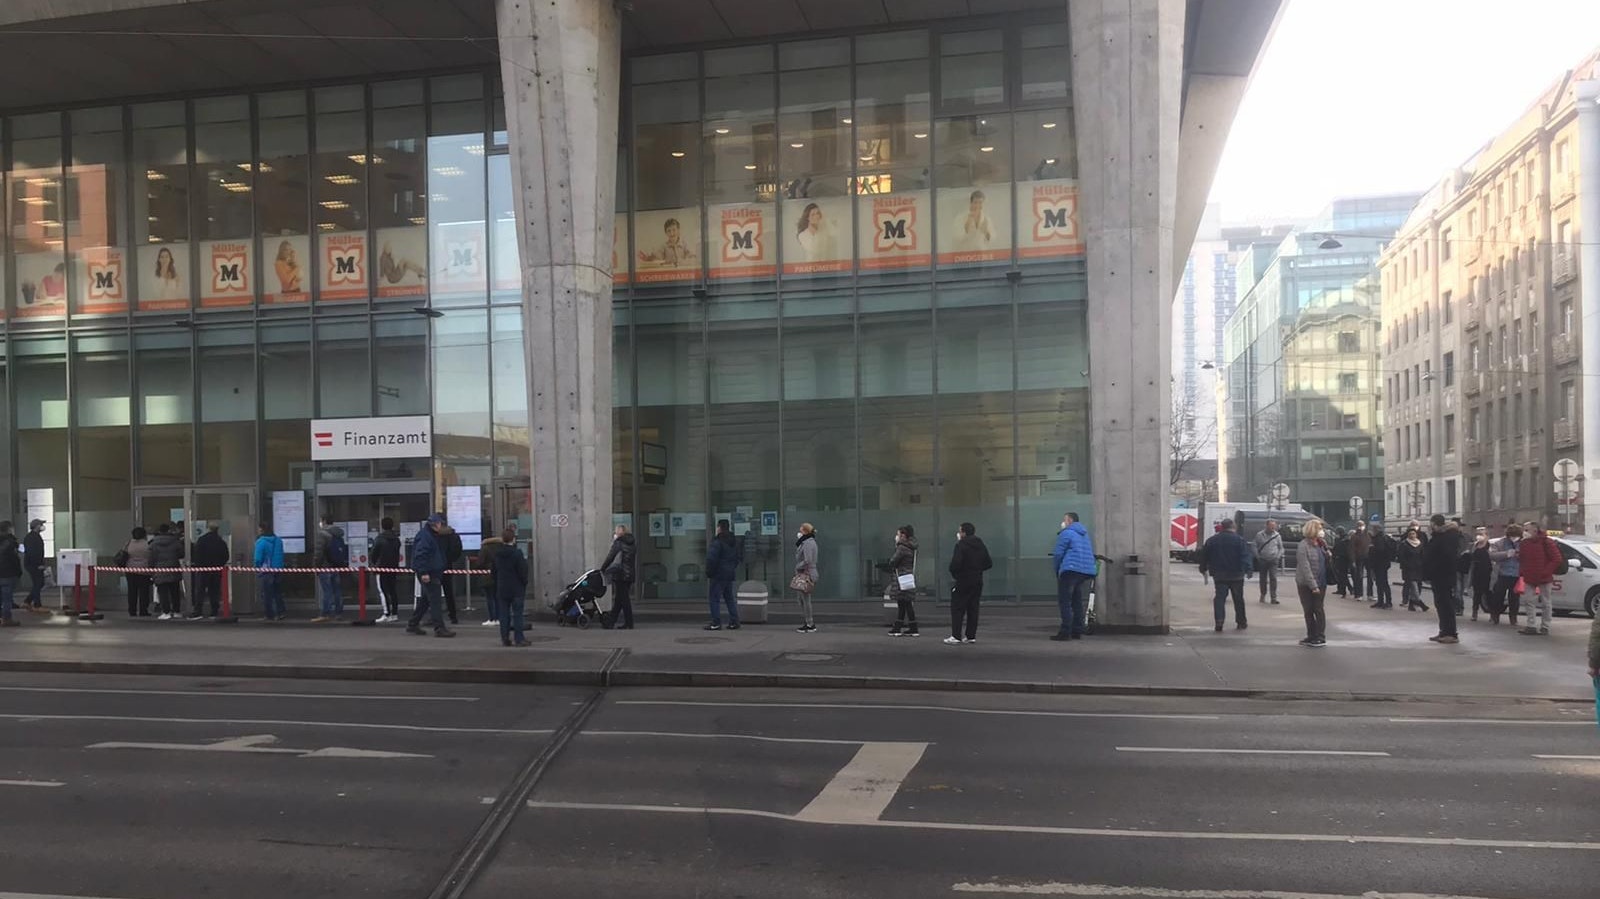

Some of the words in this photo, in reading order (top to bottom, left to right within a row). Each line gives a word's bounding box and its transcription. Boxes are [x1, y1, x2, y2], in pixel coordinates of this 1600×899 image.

[873, 196, 916, 207] Müller
[1044, 208, 1067, 228] M
[884, 219, 907, 239] M
[732, 230, 753, 250] M
[336, 256, 355, 274] M
[453, 248, 472, 266] M
[96, 271, 114, 288] M
[221, 264, 239, 281] M
[344, 431, 428, 446] Finanzamt
